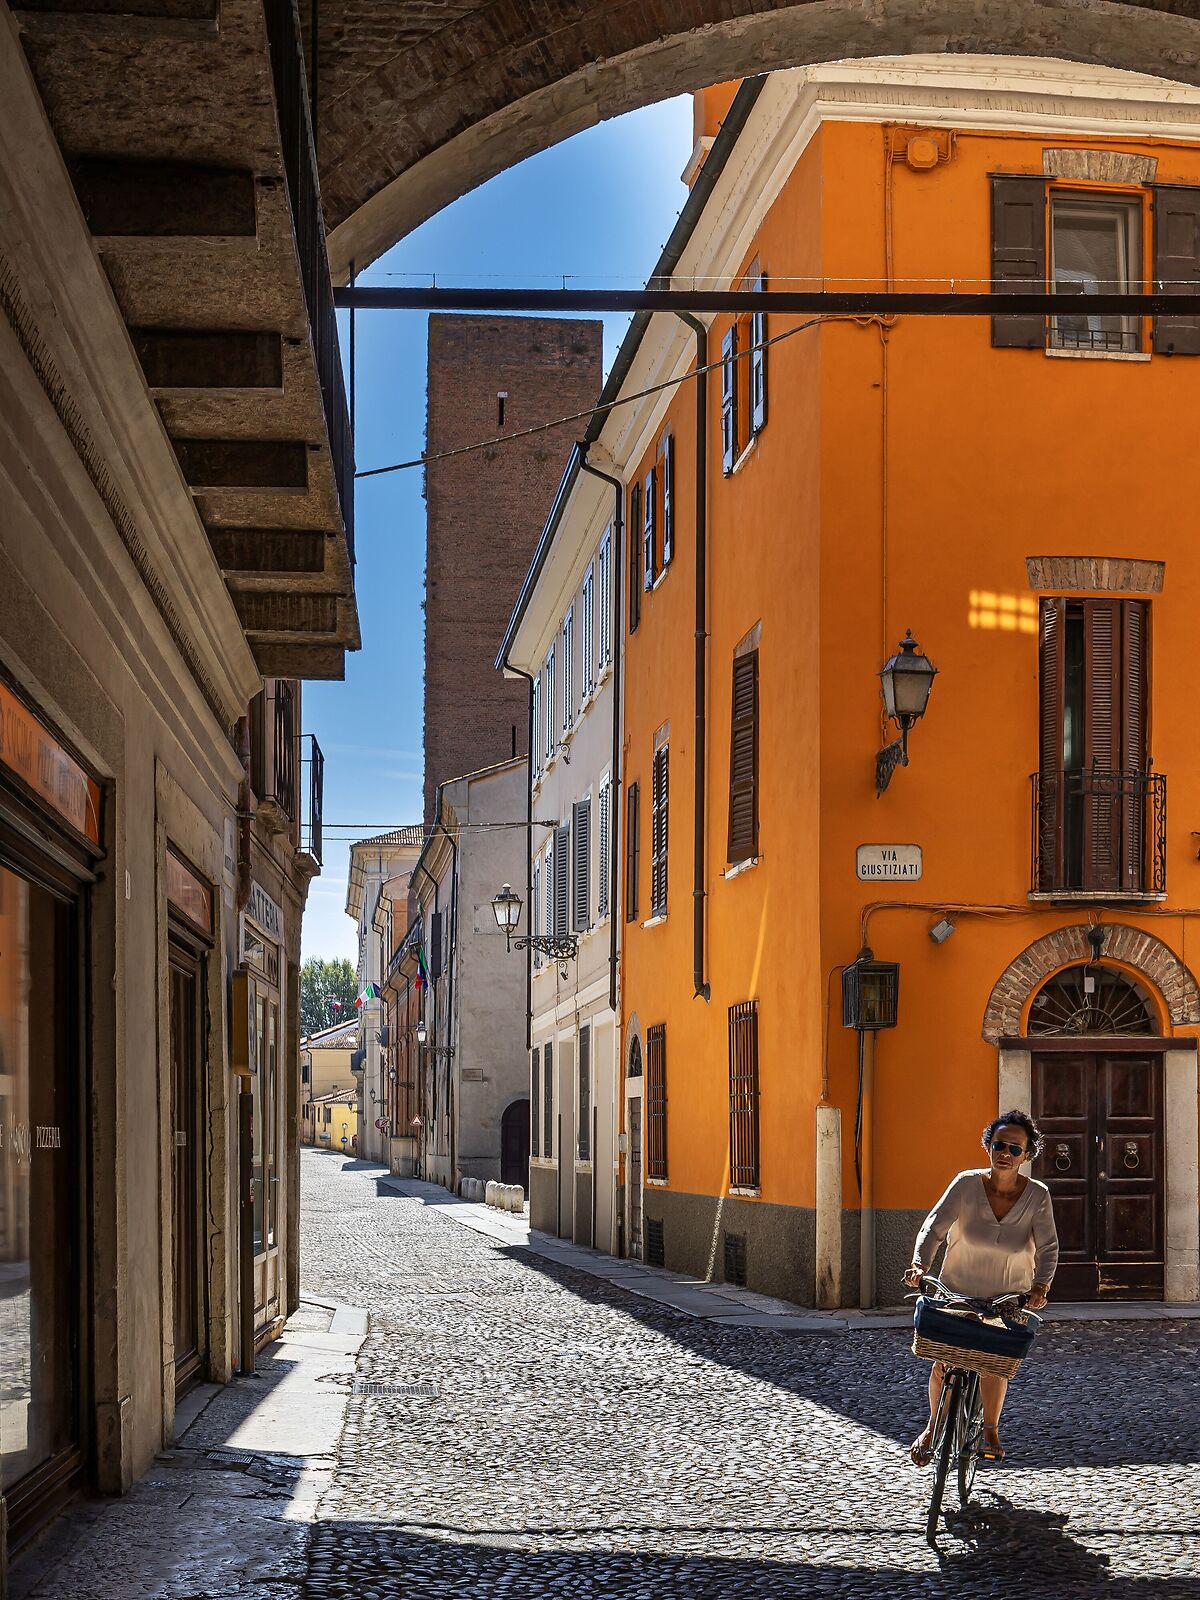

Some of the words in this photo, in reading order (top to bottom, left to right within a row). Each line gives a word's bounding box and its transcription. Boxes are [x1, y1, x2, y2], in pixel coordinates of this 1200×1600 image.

[881, 850, 897, 861] VIA
[861, 864, 918, 876] GIUSTIZIATI
[36, 1125, 61, 1149] PIZZERIA
